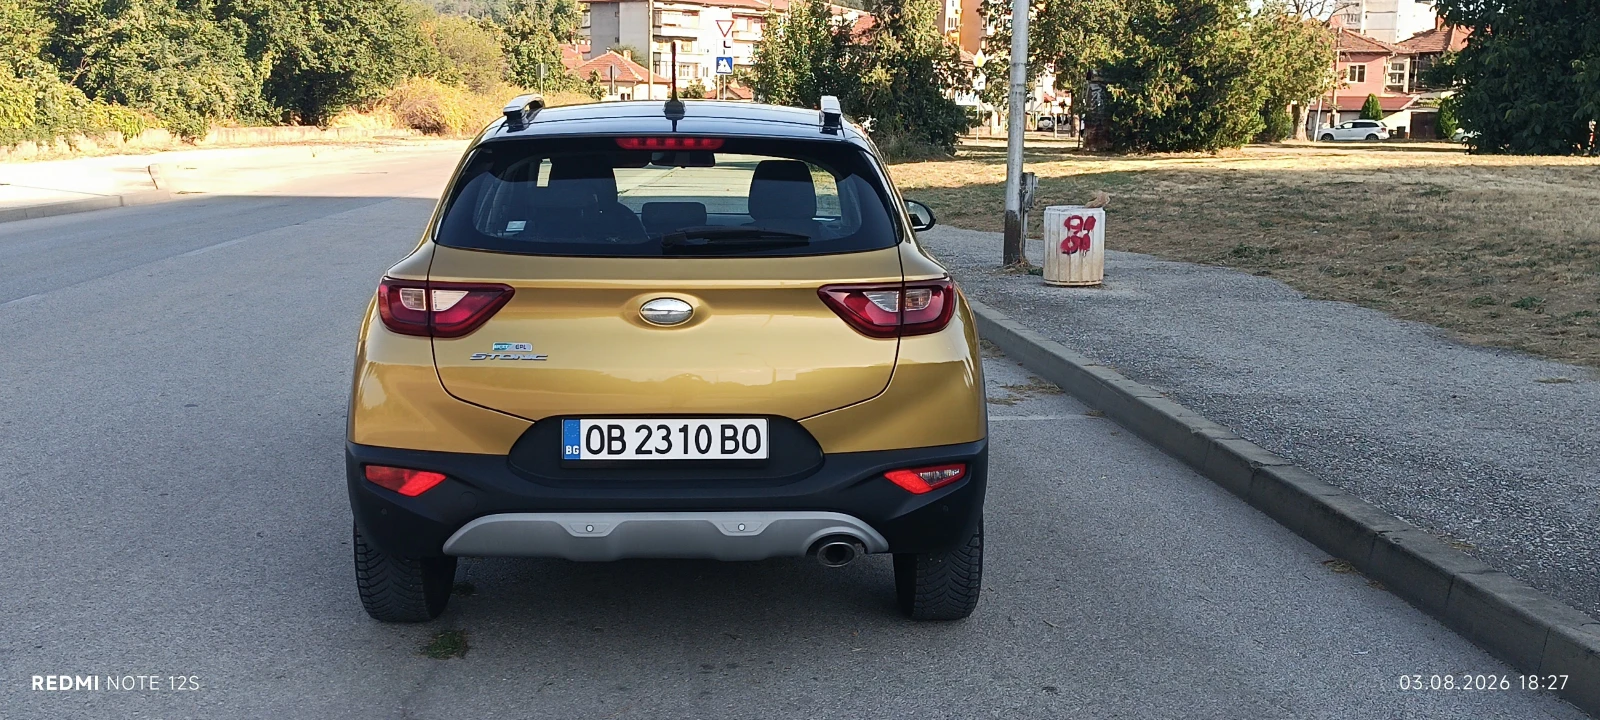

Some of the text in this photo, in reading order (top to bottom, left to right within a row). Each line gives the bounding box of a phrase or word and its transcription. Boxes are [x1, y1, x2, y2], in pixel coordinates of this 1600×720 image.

[469, 352, 549, 361] STONIC
[585, 424, 762, 455] OB 2310 BO
[565, 445, 580, 455] BG
